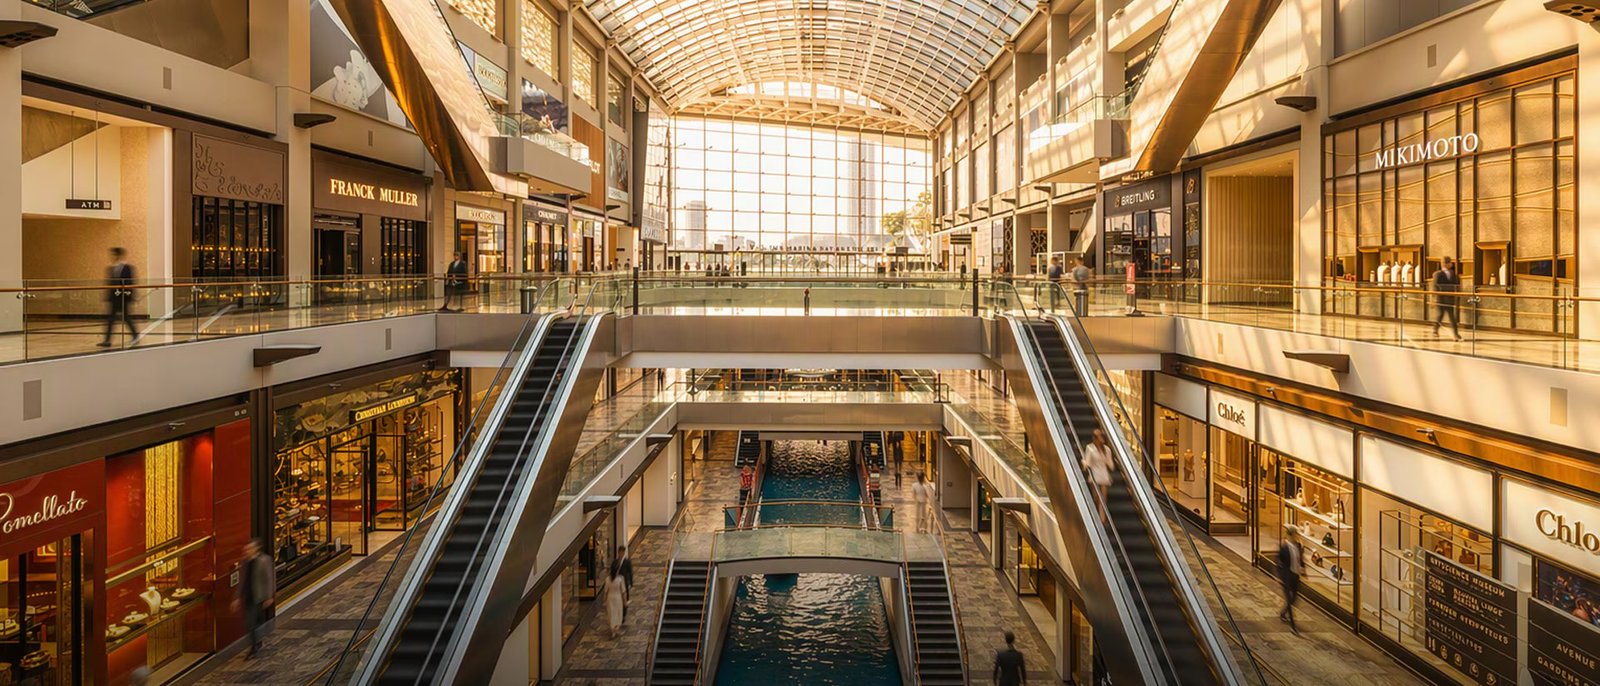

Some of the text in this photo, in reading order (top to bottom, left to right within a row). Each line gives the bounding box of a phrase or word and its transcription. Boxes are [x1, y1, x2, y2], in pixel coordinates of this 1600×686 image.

[1375, 132, 1479, 169] MIKIMOTO
[330, 178, 418, 207] FRANCK MULLER
[1121, 189, 1155, 206] BREITLING
[1535, 509, 1600, 553] Chlo
[1556, 643, 1596, 669] AVENUE
